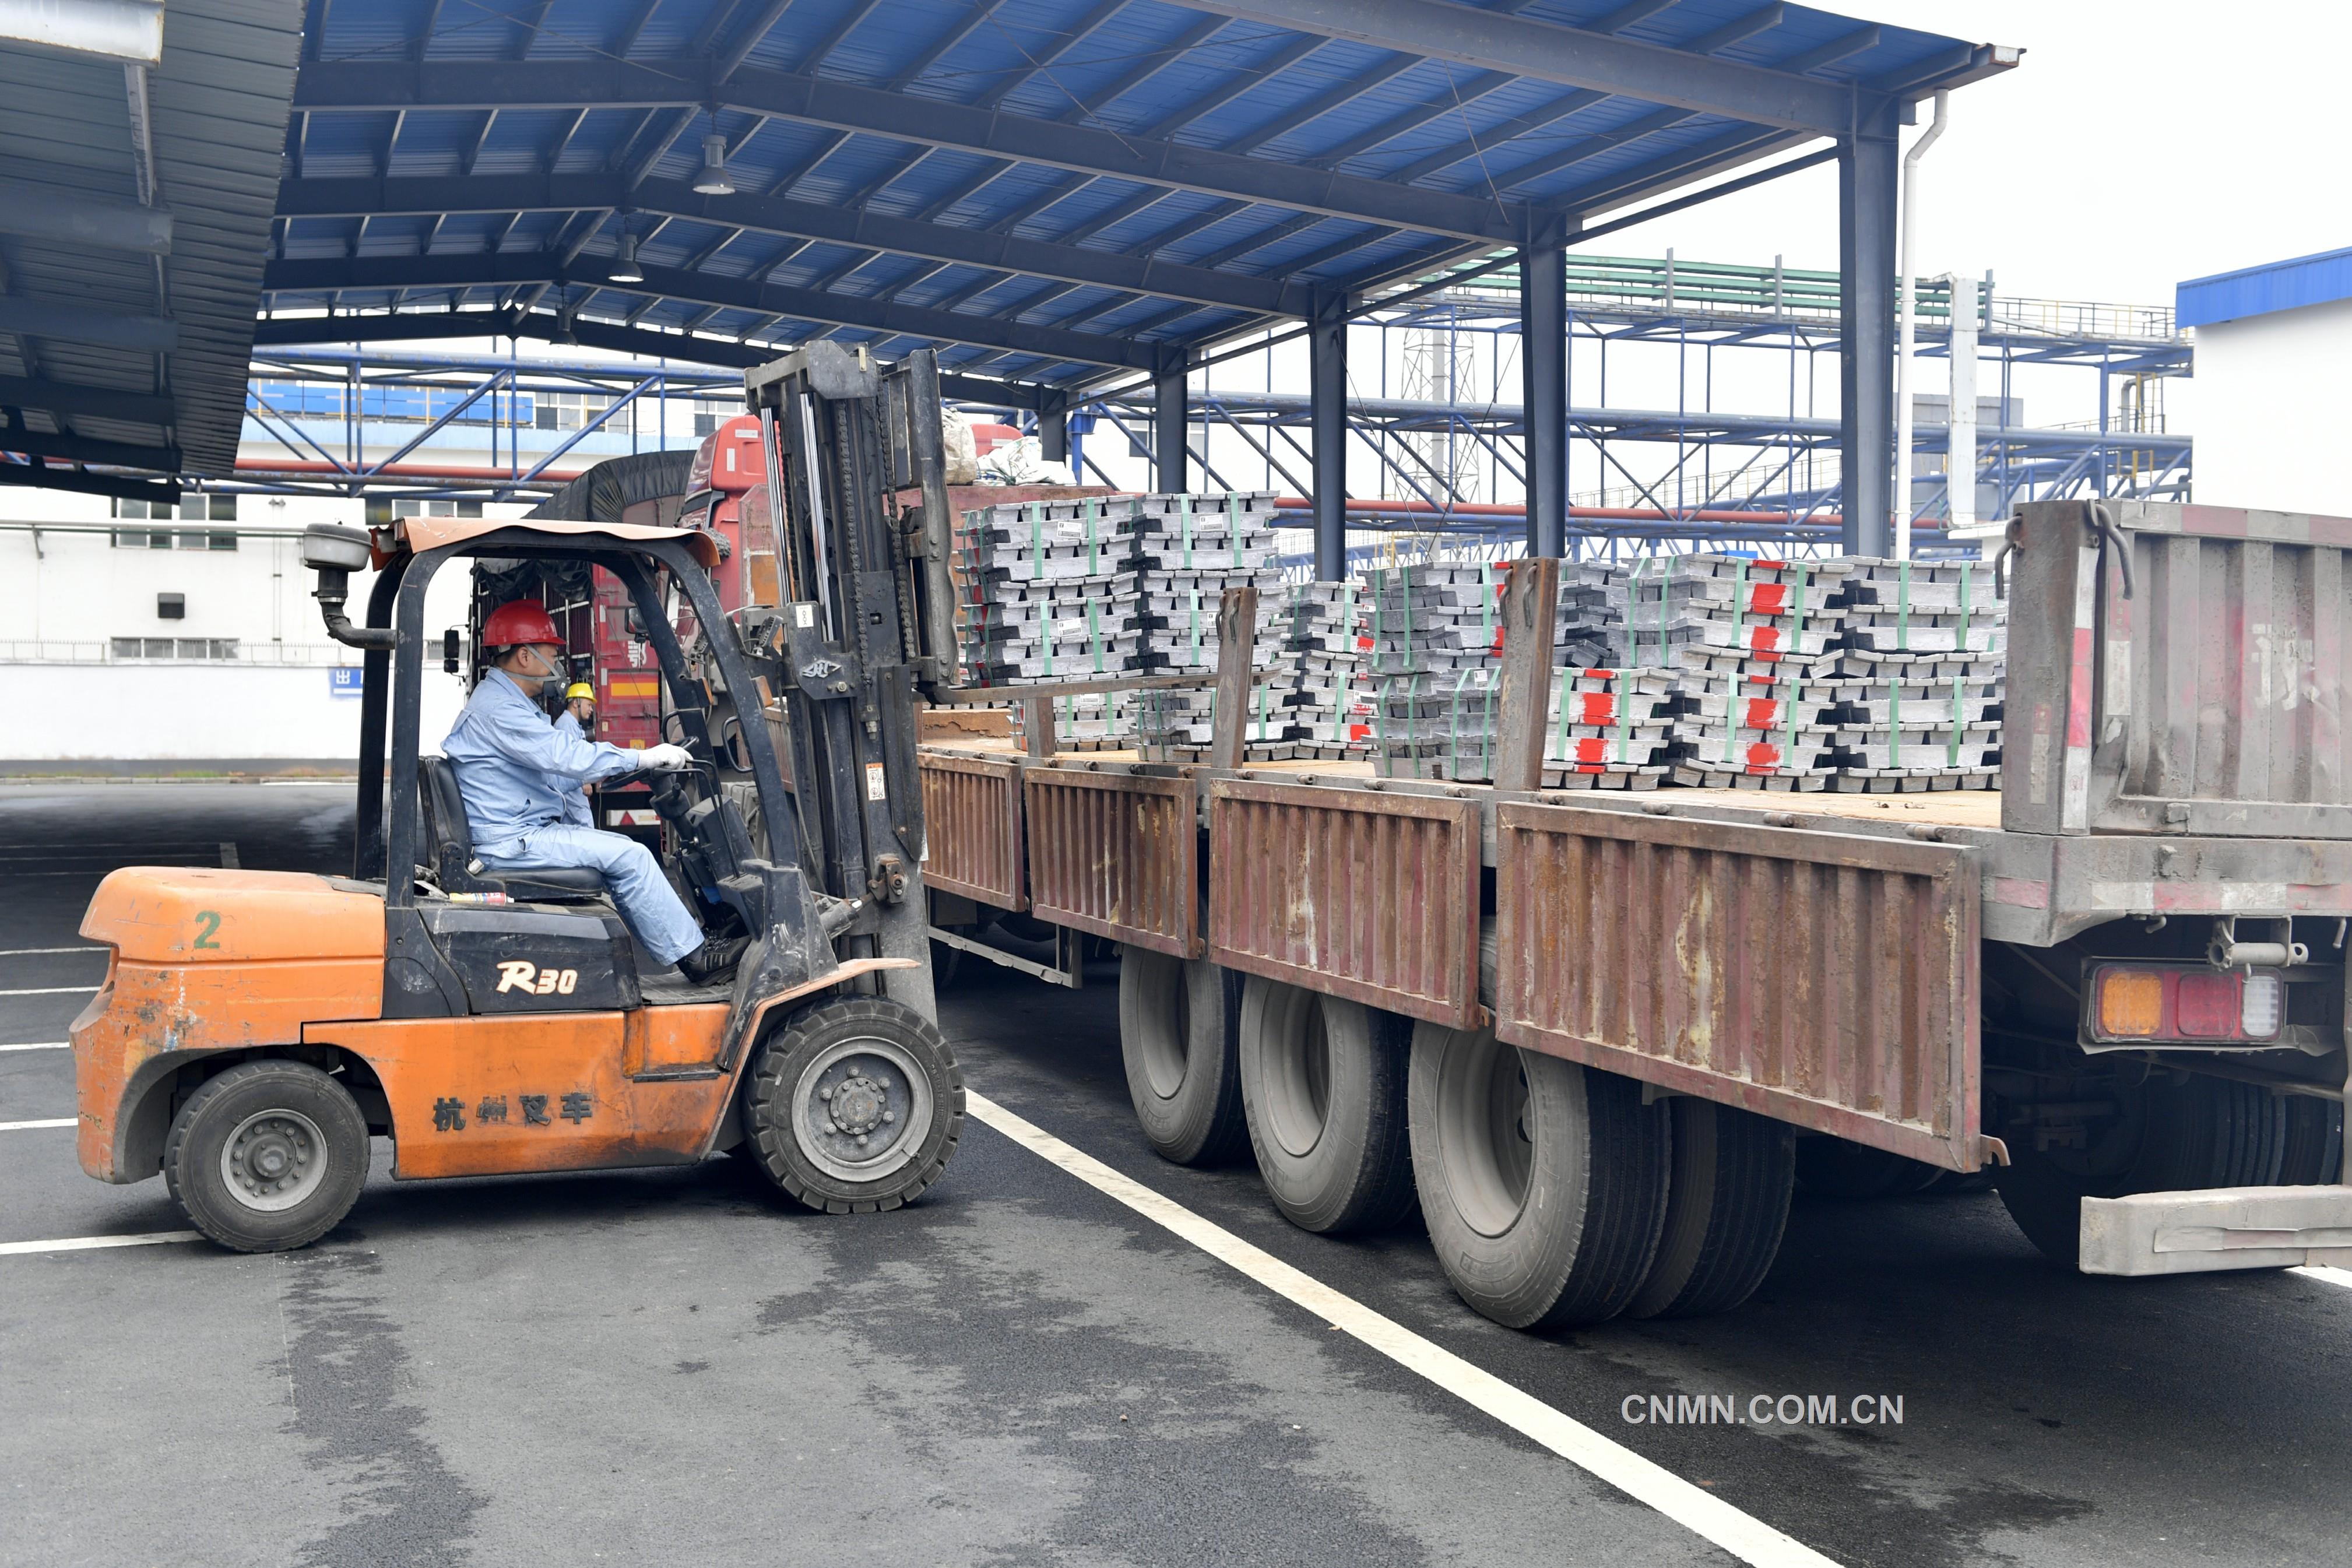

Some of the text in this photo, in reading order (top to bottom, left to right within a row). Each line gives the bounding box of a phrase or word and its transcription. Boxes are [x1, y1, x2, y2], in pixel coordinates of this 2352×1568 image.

[336, 670, 364, 684] 出
[194, 910, 220, 949] 2
[496, 960, 578, 996] R30
[432, 1092, 593, 1131] 杭州叉车
